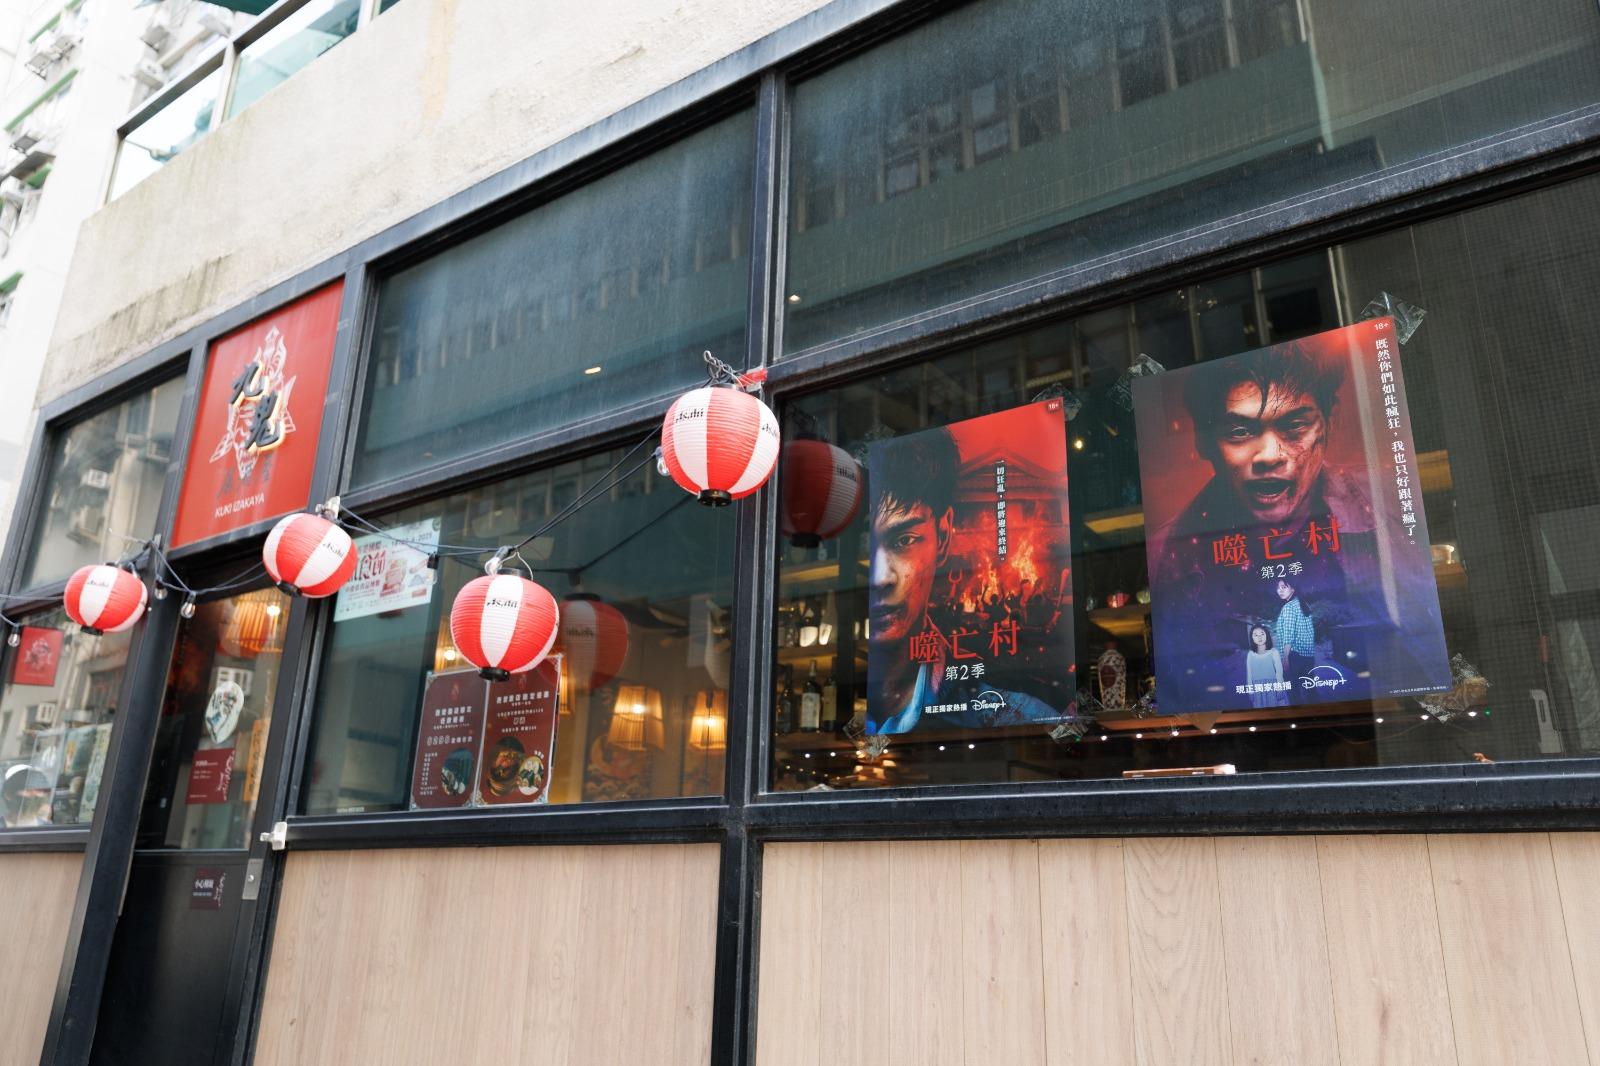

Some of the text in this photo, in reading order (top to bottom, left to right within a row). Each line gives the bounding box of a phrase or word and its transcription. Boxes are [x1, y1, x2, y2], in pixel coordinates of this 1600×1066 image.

[1374, 322, 1389, 331] 18+
[675, 408, 705, 422] Asahi
[214, 492, 265, 519] KUKI IZAKAYA
[1212, 514, 1343, 567] 噬亡村
[1261, 561, 1303, 579] 第2季
[487, 598, 518, 608] Asahi
[909, 620, 1021, 664] 噬亡村
[945, 662, 985, 681] 第2季
[1299, 666, 1348, 690] Disney+
[1236, 681, 1292, 694] 現正獨家熱播
[924, 703, 968, 714] 現正獨家熱播
[970, 690, 1007, 712] Disney+
